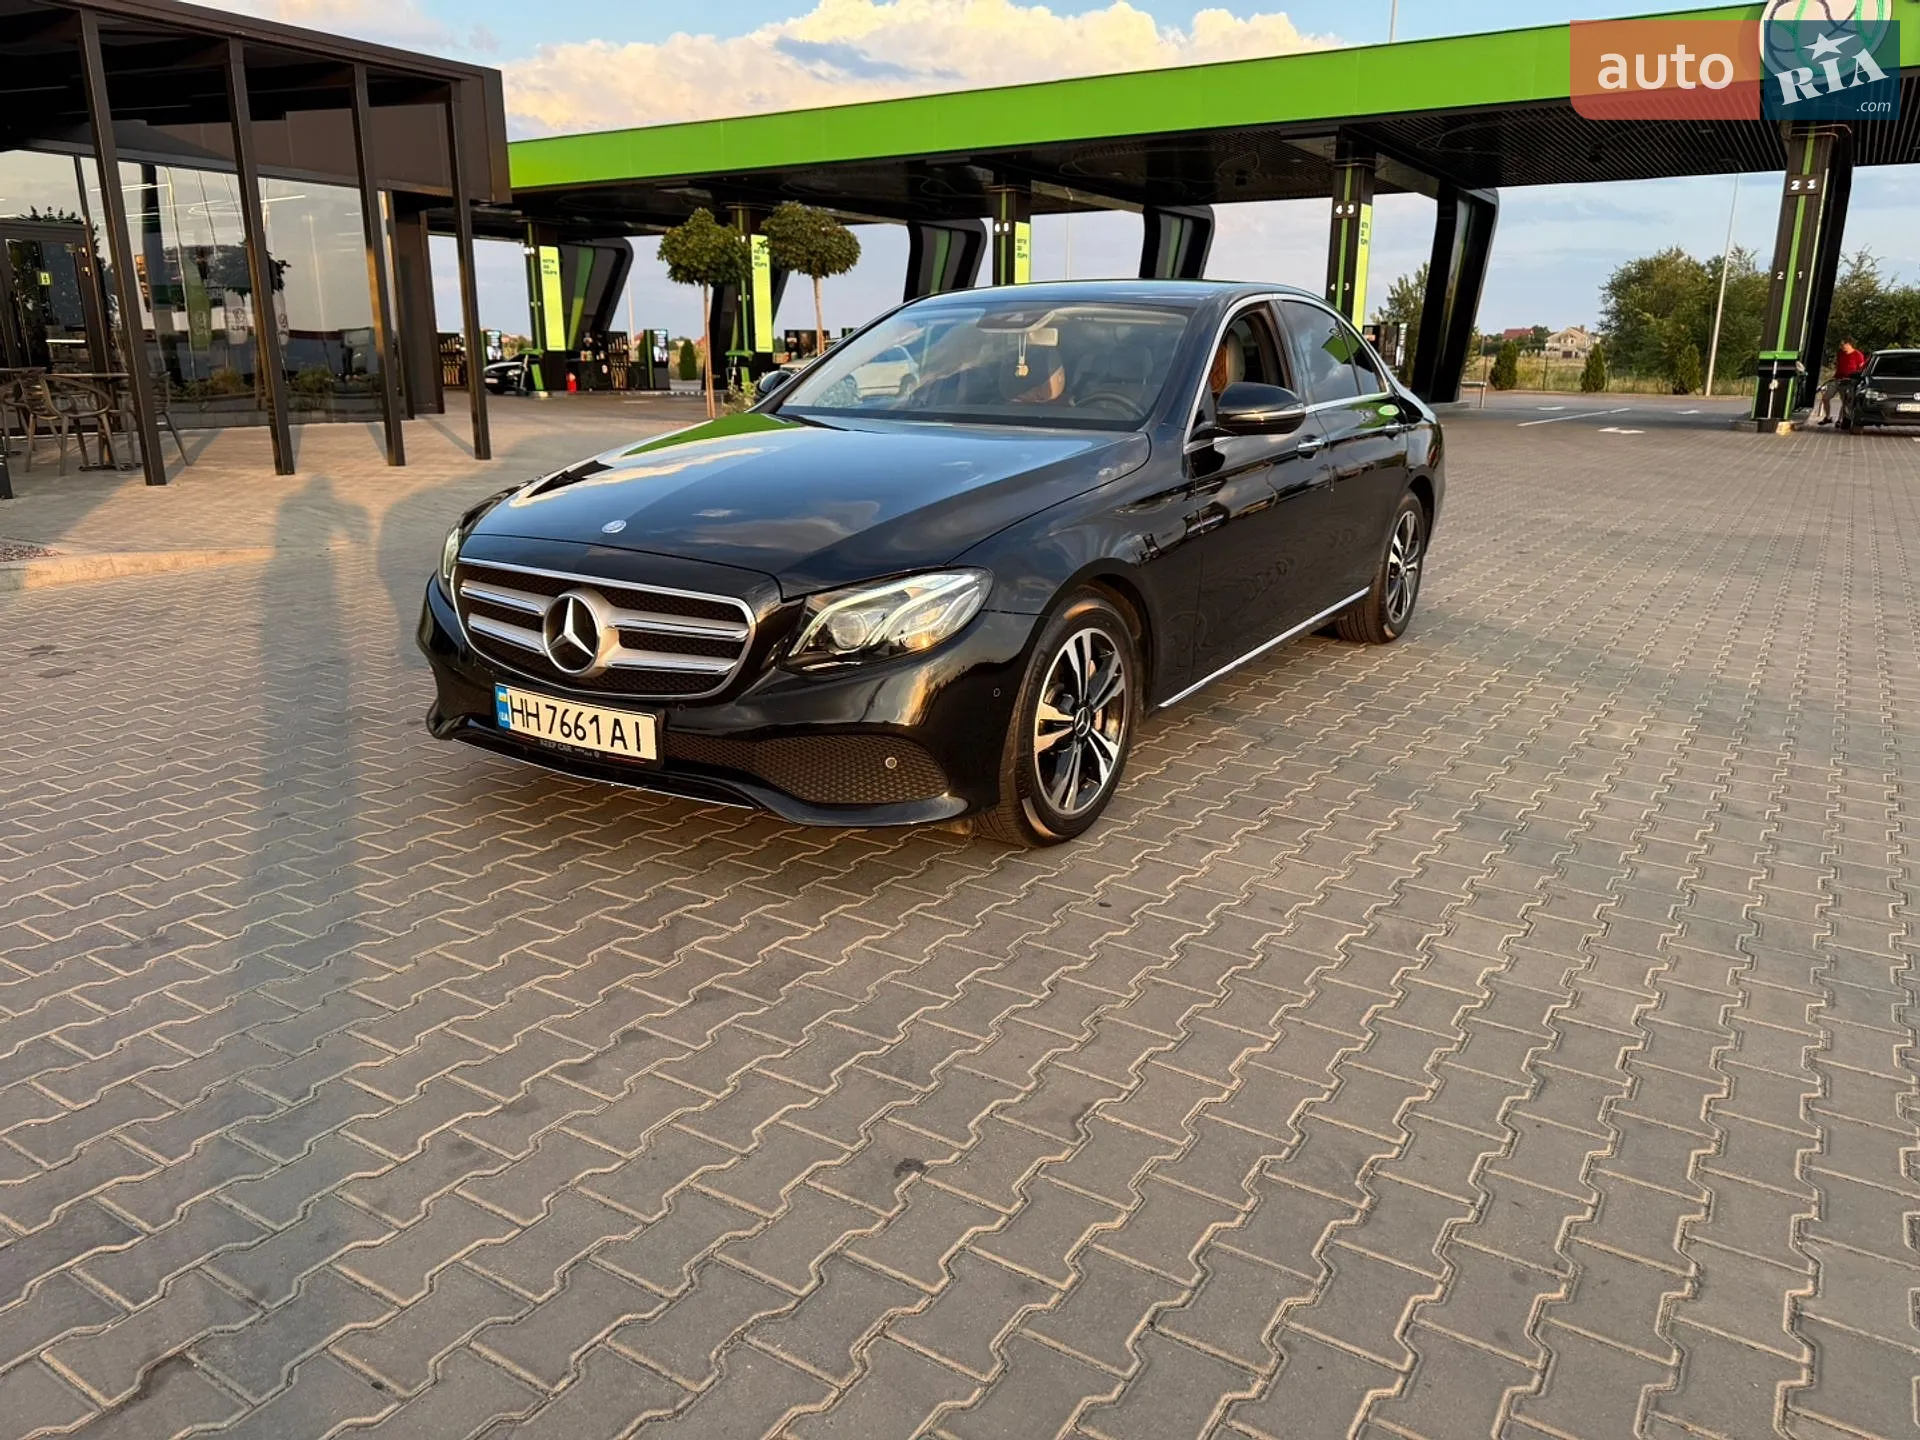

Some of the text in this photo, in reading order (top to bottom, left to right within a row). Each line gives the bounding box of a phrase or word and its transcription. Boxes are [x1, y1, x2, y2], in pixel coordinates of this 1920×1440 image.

[1790, 180, 1816, 190] 2 1
[1336, 203, 1355, 214] 4 3
[1776, 270, 1804, 280] 2 1
[1329, 282, 1350, 292] 4 3
